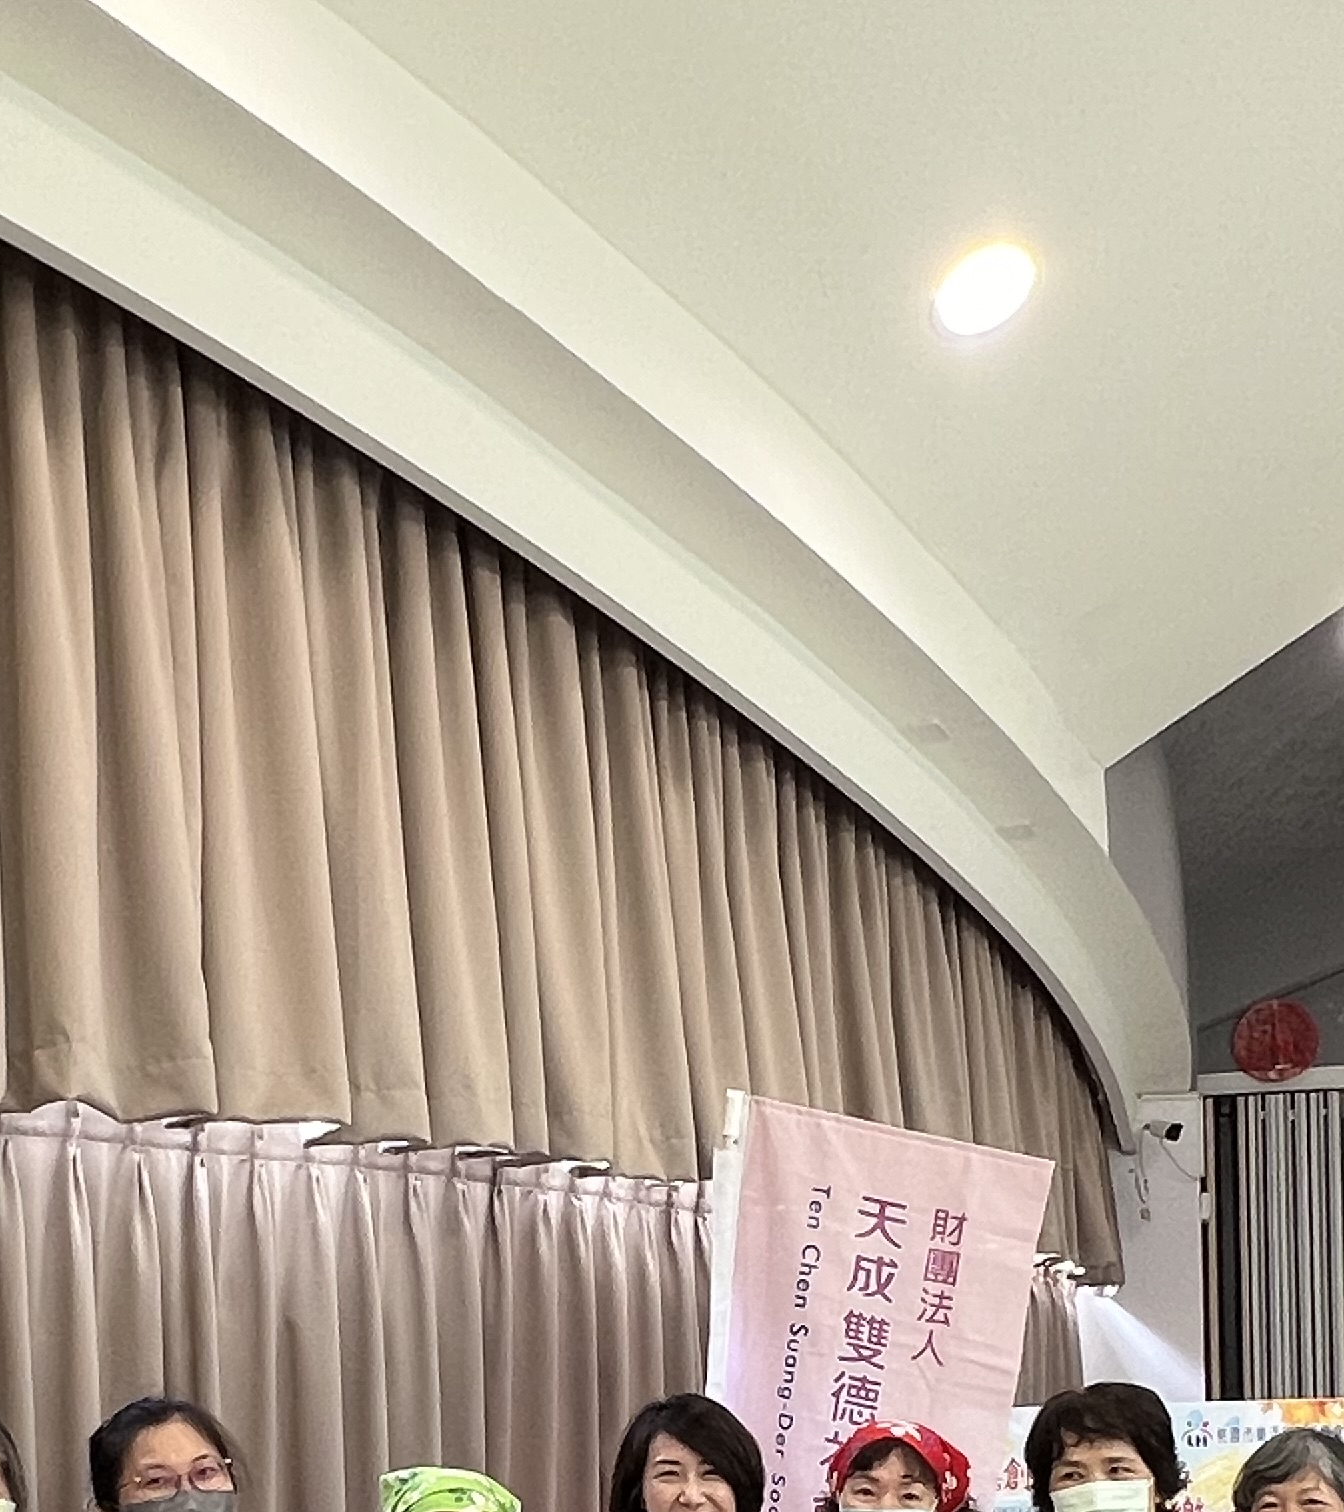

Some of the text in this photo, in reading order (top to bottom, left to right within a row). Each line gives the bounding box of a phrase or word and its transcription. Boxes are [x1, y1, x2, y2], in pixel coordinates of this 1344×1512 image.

[806, 1185, 832, 1231] Ten
[793, 1243, 822, 1310] Chen
[911, 1207, 968, 1368] 財團法人
[774, 1322, 810, 1459] Suang-Der
